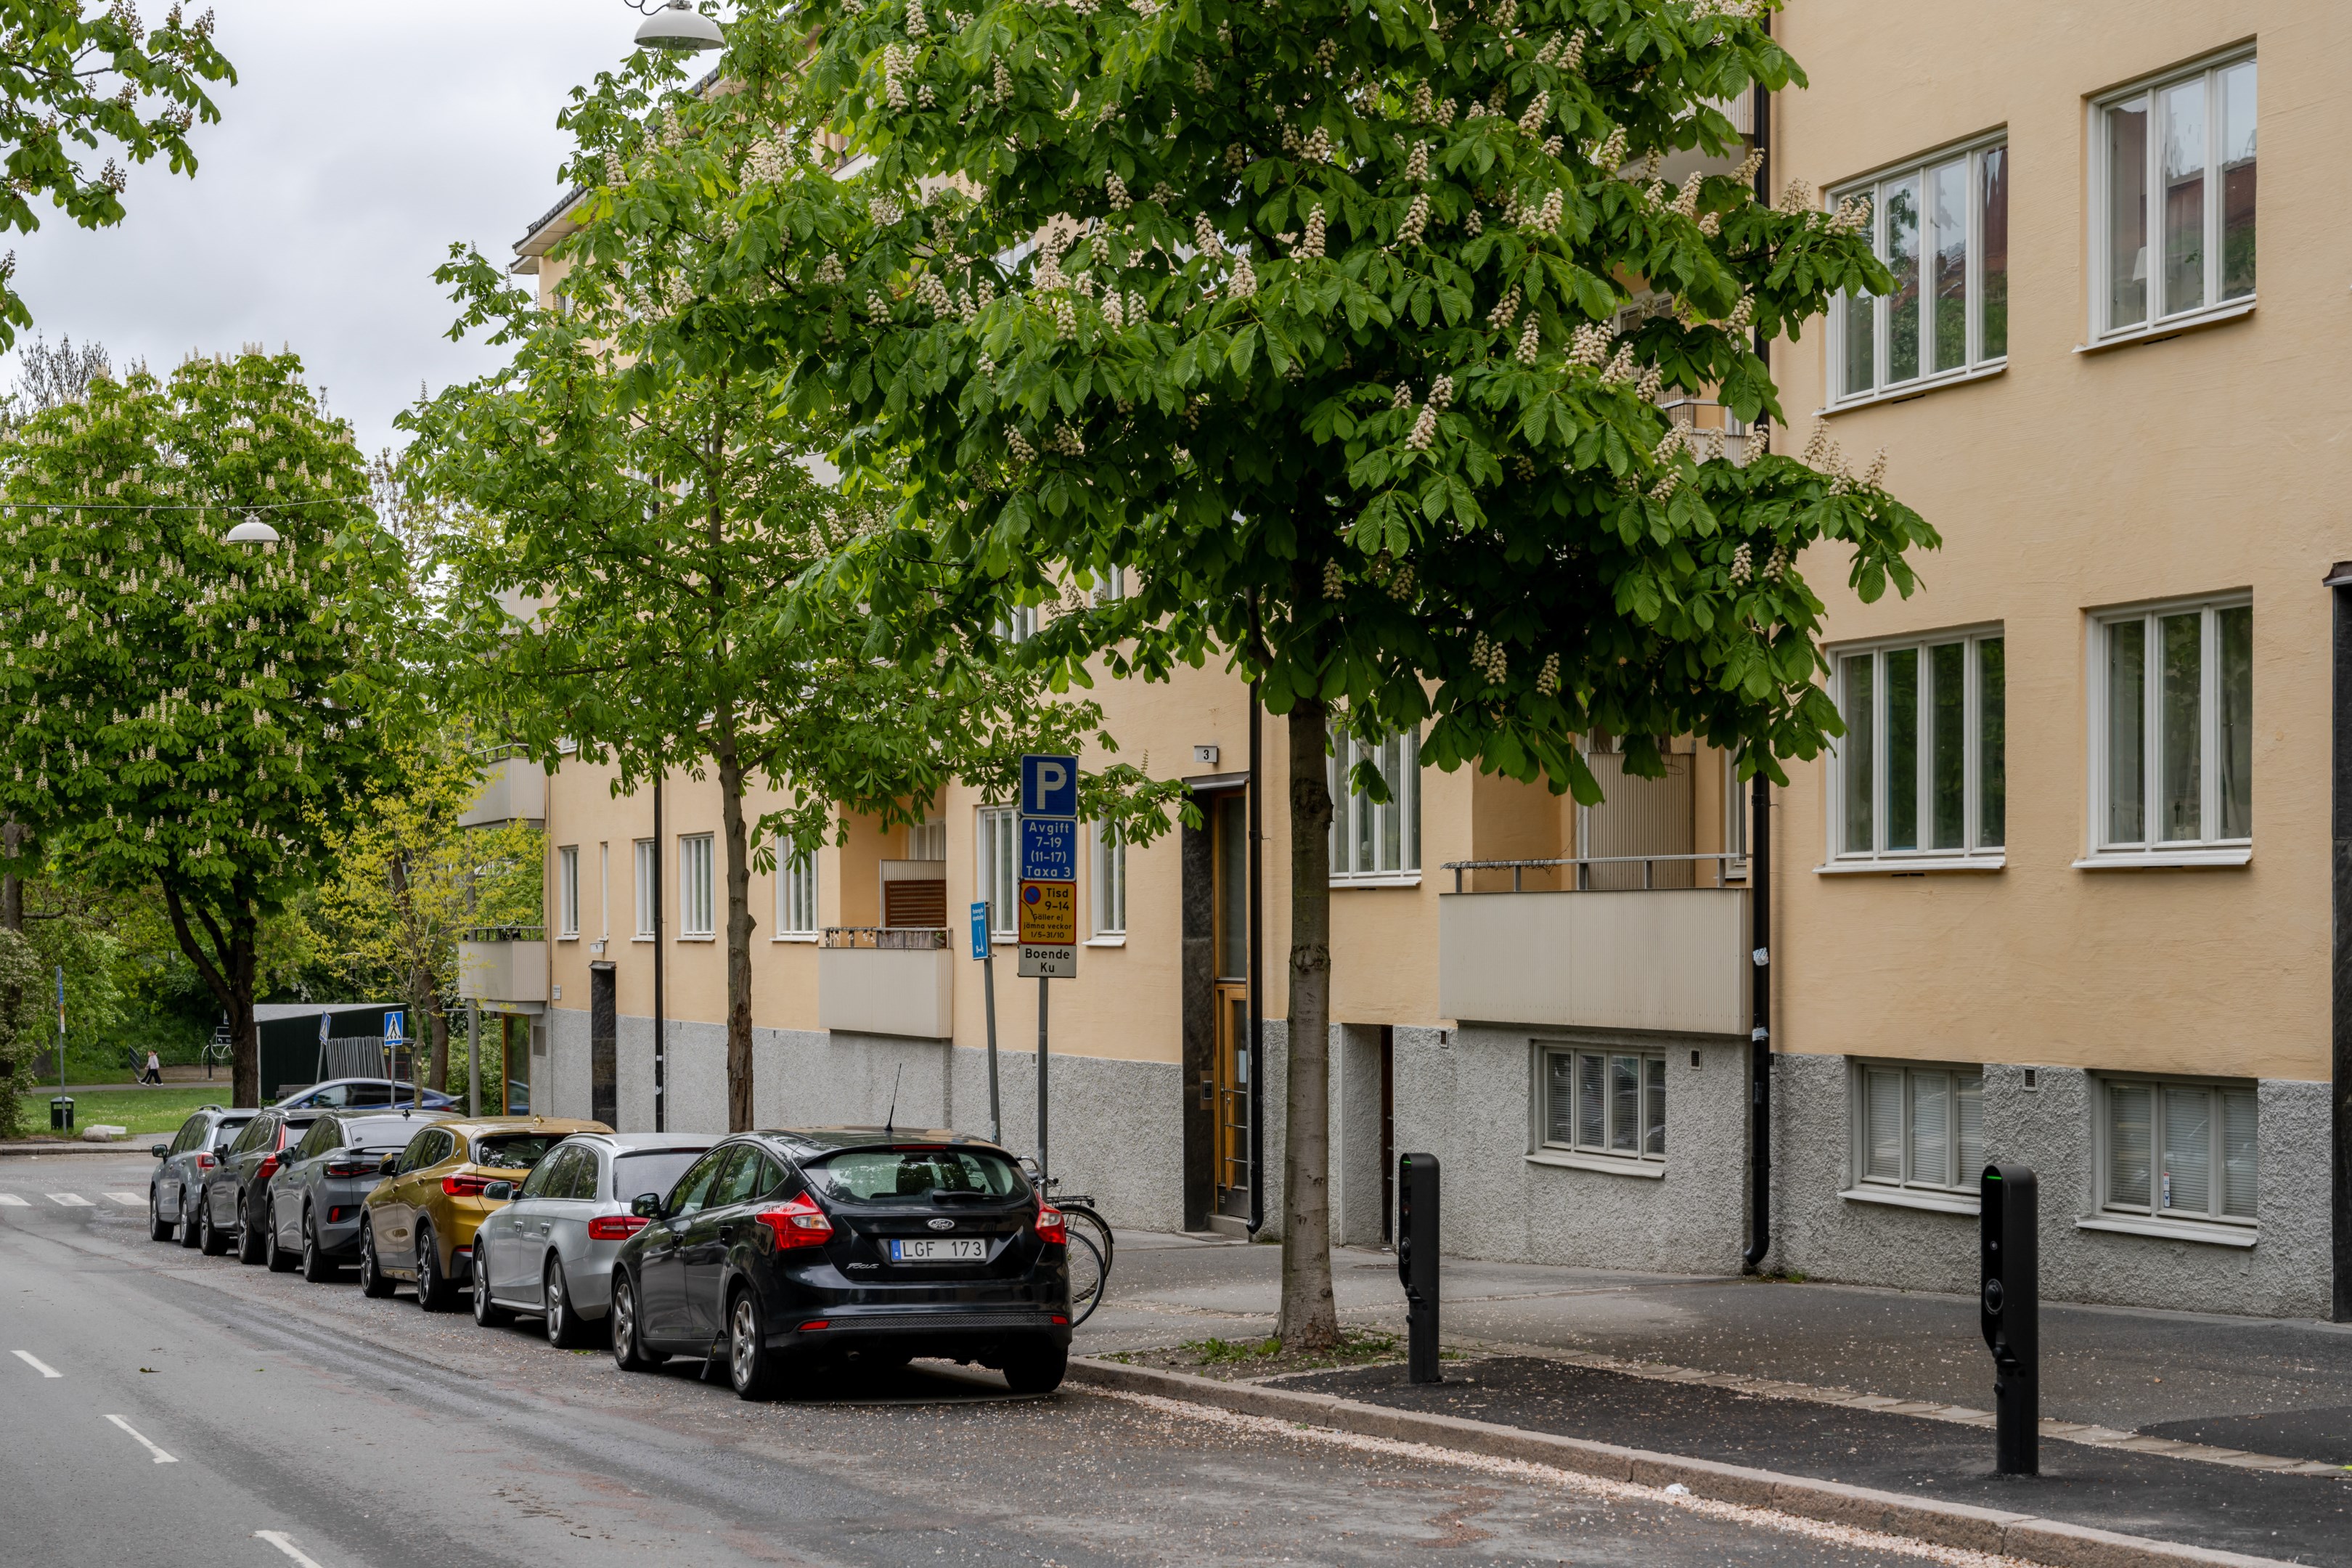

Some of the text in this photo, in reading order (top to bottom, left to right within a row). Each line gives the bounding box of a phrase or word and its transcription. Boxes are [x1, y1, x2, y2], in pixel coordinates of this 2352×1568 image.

[1204, 749, 1209, 760] 3
[1037, 761, 1067, 809] P
[1029, 822, 1069, 836] Avgift
[1036, 836, 1062, 848] 7-19
[1031, 849, 1066, 864] (11-17)
[1026, 865, 1071, 878] Taxa 3
[1046, 887, 1069, 898] Tisd
[1045, 901, 1069, 911] 9-14
[1025, 948, 1070, 960] Boende
[1040, 962, 1055, 973] Ku
[902, 1241, 981, 1257] LGF 173
